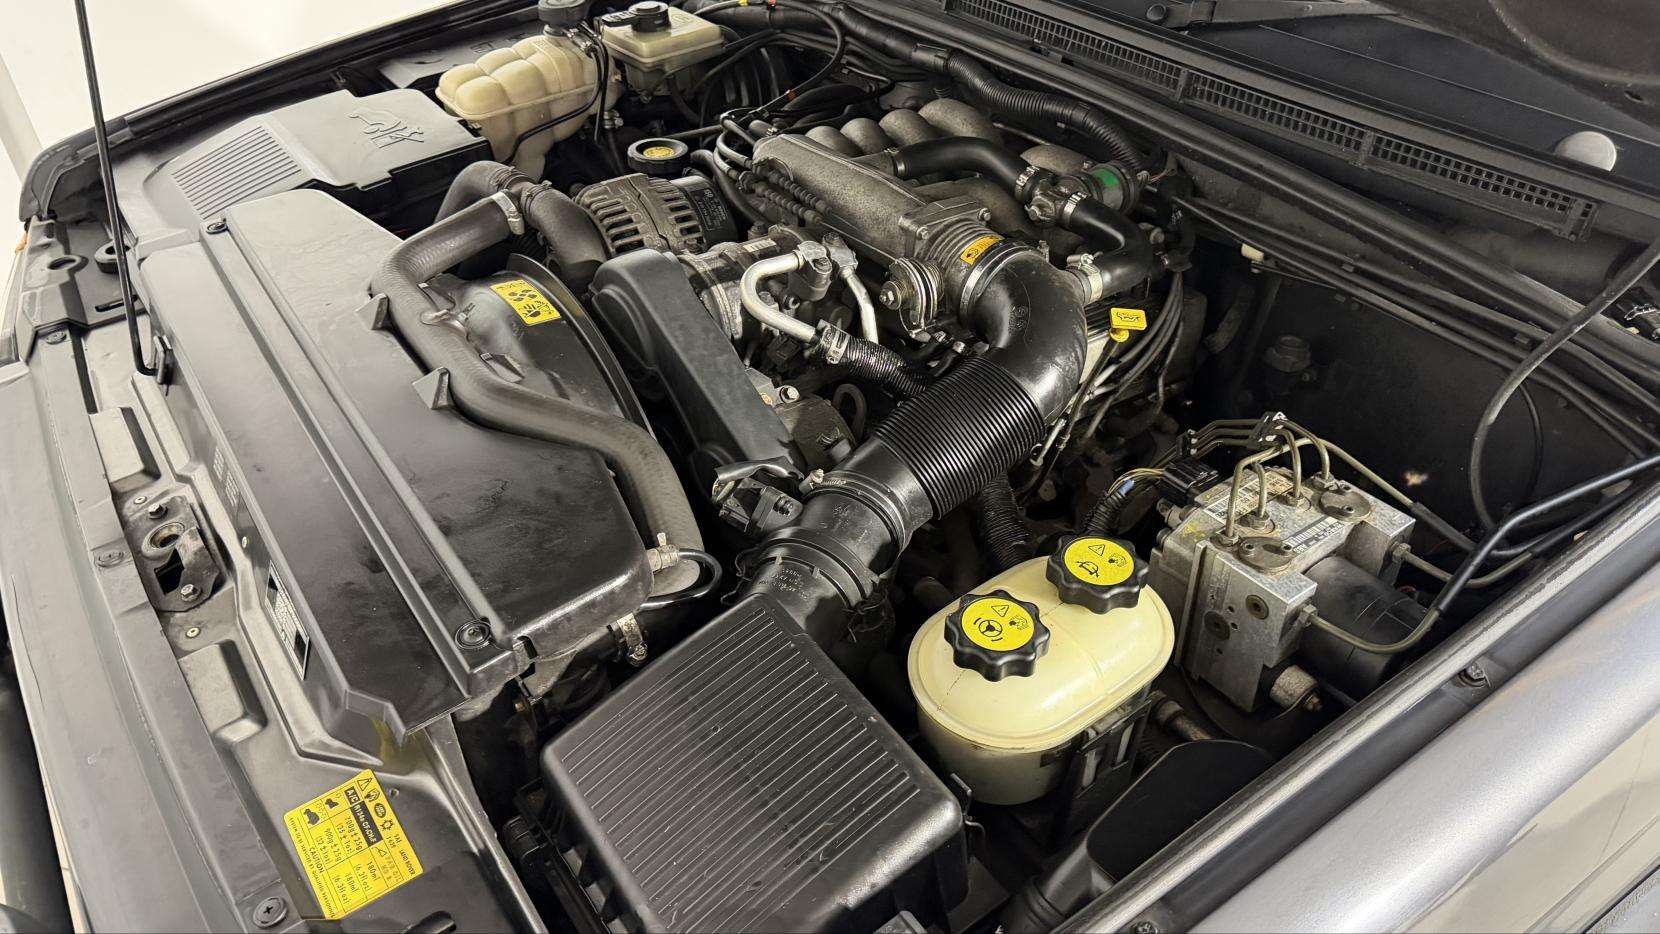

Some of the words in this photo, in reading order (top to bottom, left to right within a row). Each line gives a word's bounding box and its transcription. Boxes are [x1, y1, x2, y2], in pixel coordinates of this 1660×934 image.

[346, 788, 357, 802] A/C
[353, 803, 366, 822] R134a
[352, 836, 364, 851] 25g
[308, 846, 324, 873] CAUTION
[331, 848, 343, 862] 25g
[365, 860, 380, 882] 180ml
[404, 859, 416, 875] ROVER
[344, 873, 357, 893] 180ml
